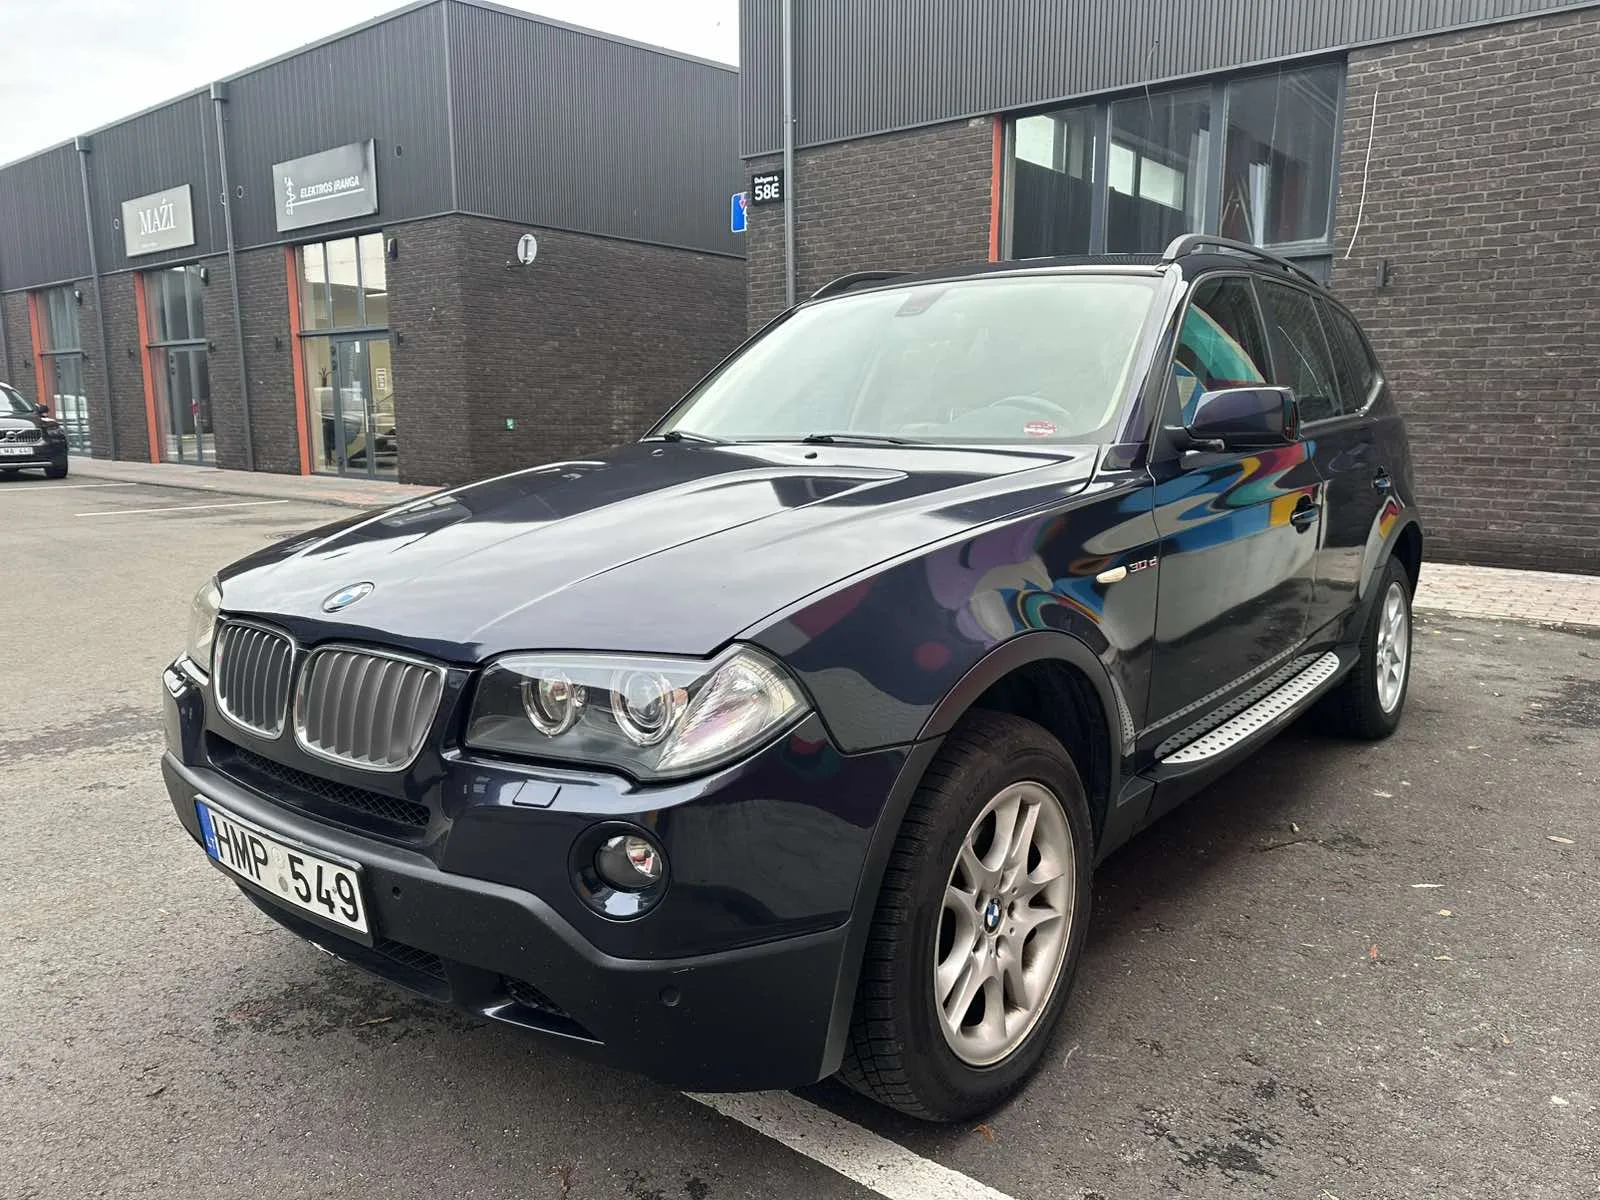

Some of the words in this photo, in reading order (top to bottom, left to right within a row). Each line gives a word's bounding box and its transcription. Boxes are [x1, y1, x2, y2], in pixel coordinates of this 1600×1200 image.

[300, 181, 333, 198] ELEKTROS
[754, 183, 780, 201] 58E
[211, 815, 268, 881] HMP
[287, 853, 359, 922] 549
